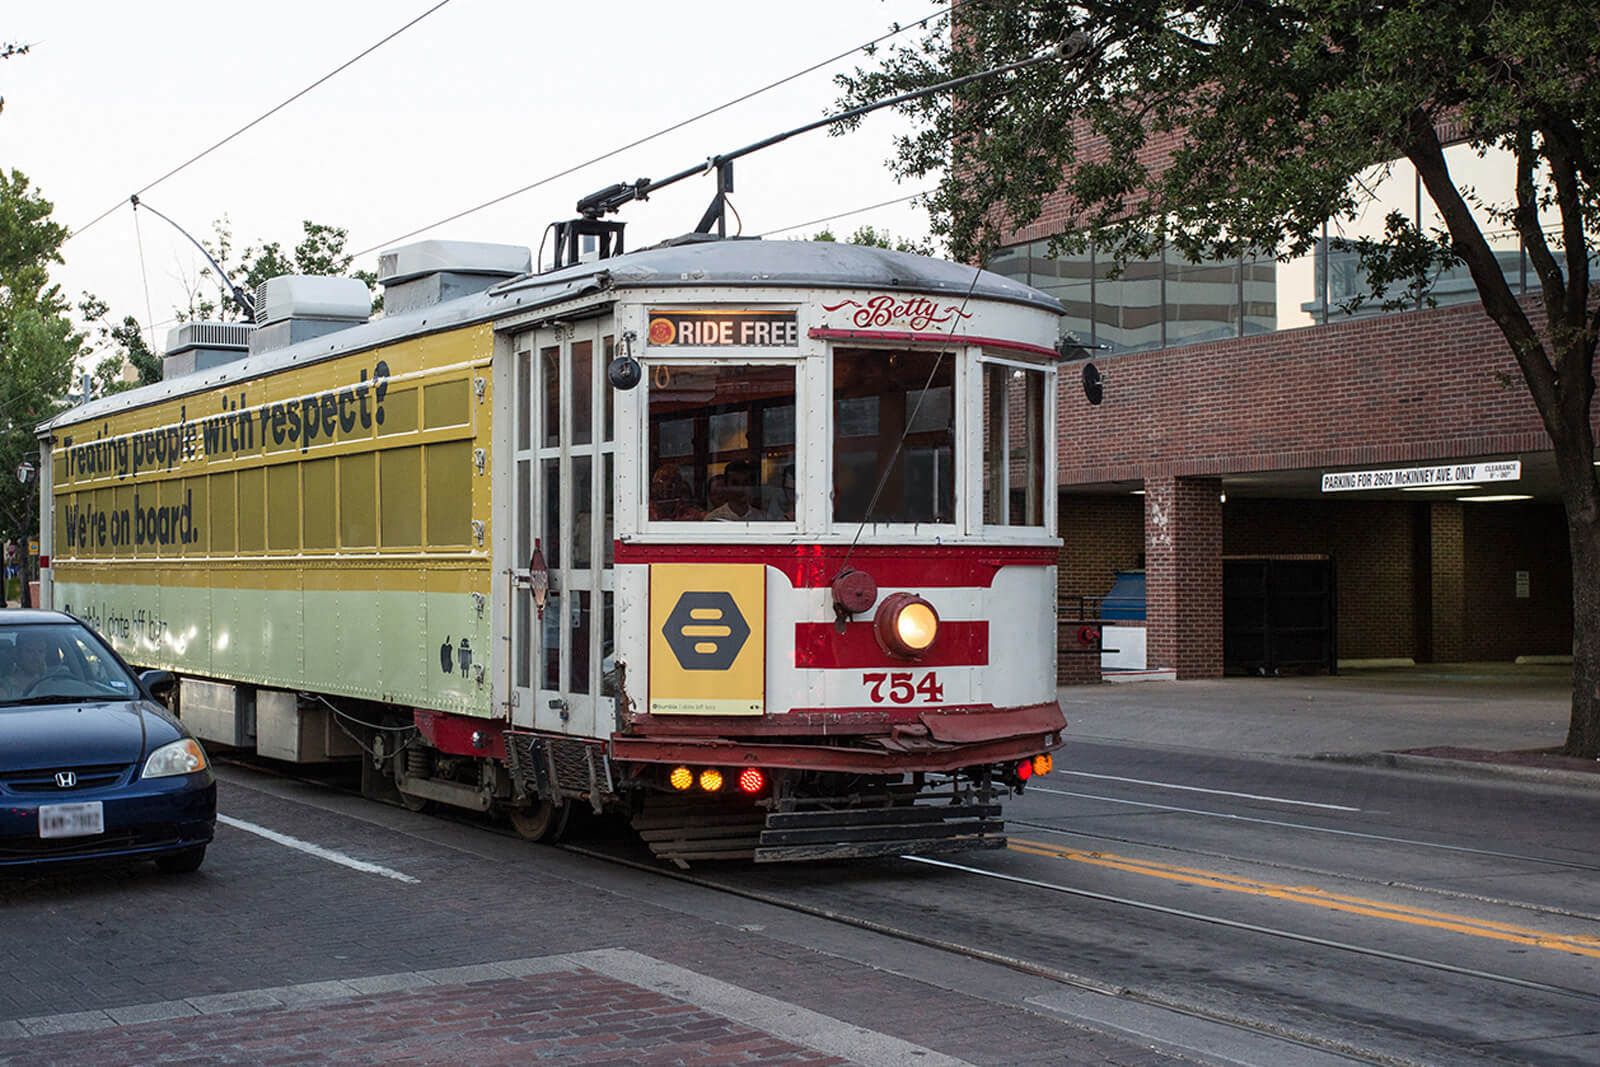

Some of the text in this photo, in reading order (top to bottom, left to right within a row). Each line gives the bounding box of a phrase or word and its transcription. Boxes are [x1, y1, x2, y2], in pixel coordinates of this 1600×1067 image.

[853, 296, 951, 331] Betty
[678, 320, 797, 345] RIDE FREE
[64, 360, 390, 480] Treating people with respect?
[1324, 474, 1356, 489] PARKING
[1357, 472, 1373, 488] FOR
[1374, 471, 1394, 486] 2602
[1394, 468, 1435, 485] McKINNEY
[1455, 465, 1476, 481] ONLY
[65, 488, 198, 548] We're on board.
[863, 671, 944, 704] 754
